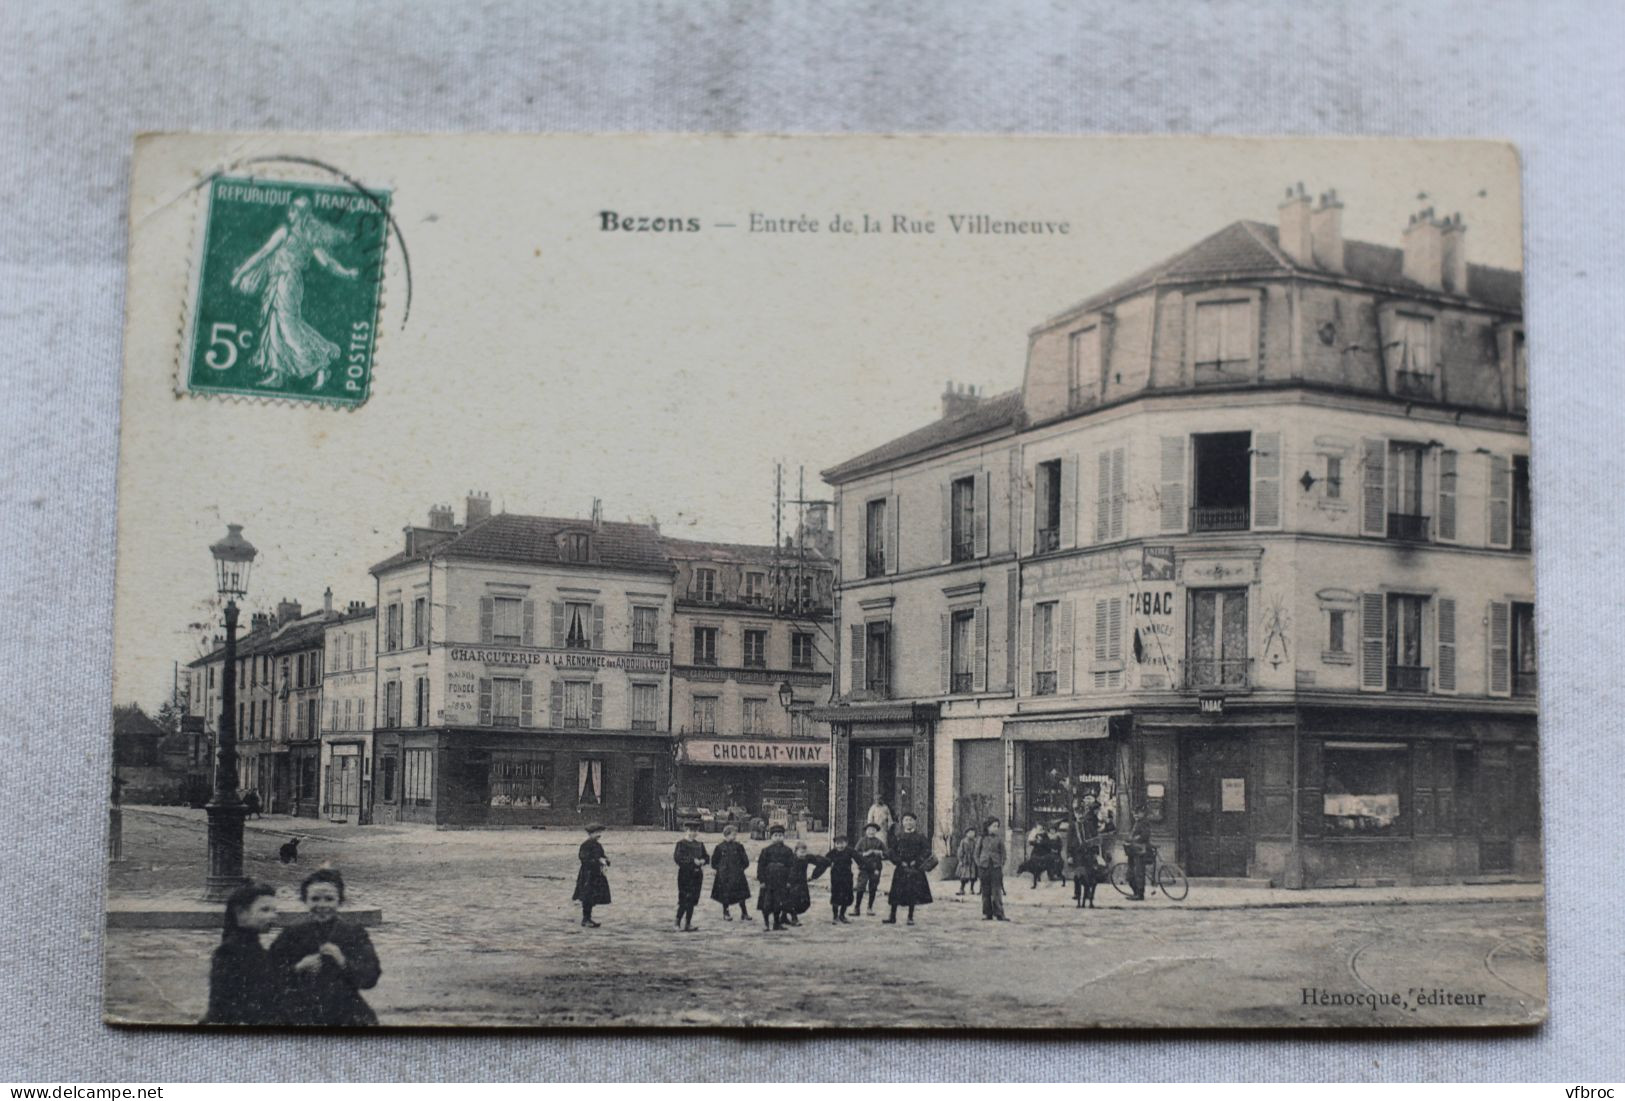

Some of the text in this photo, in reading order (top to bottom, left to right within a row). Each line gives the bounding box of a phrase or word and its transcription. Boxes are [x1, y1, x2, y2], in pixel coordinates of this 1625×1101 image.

[599, 210, 1071, 235] Bezons Entrée de la Rue Villeneuve
[345, 320, 370, 392] POSTES
[1128, 591, 1173, 616] TABAC
[451, 648, 541, 665] CHARCUTERIE
[553, 655, 564, 666] LA
[1200, 699, 1222, 712] TABAC
[1301, 987, 1486, 1011] Hénocque, éditeur
